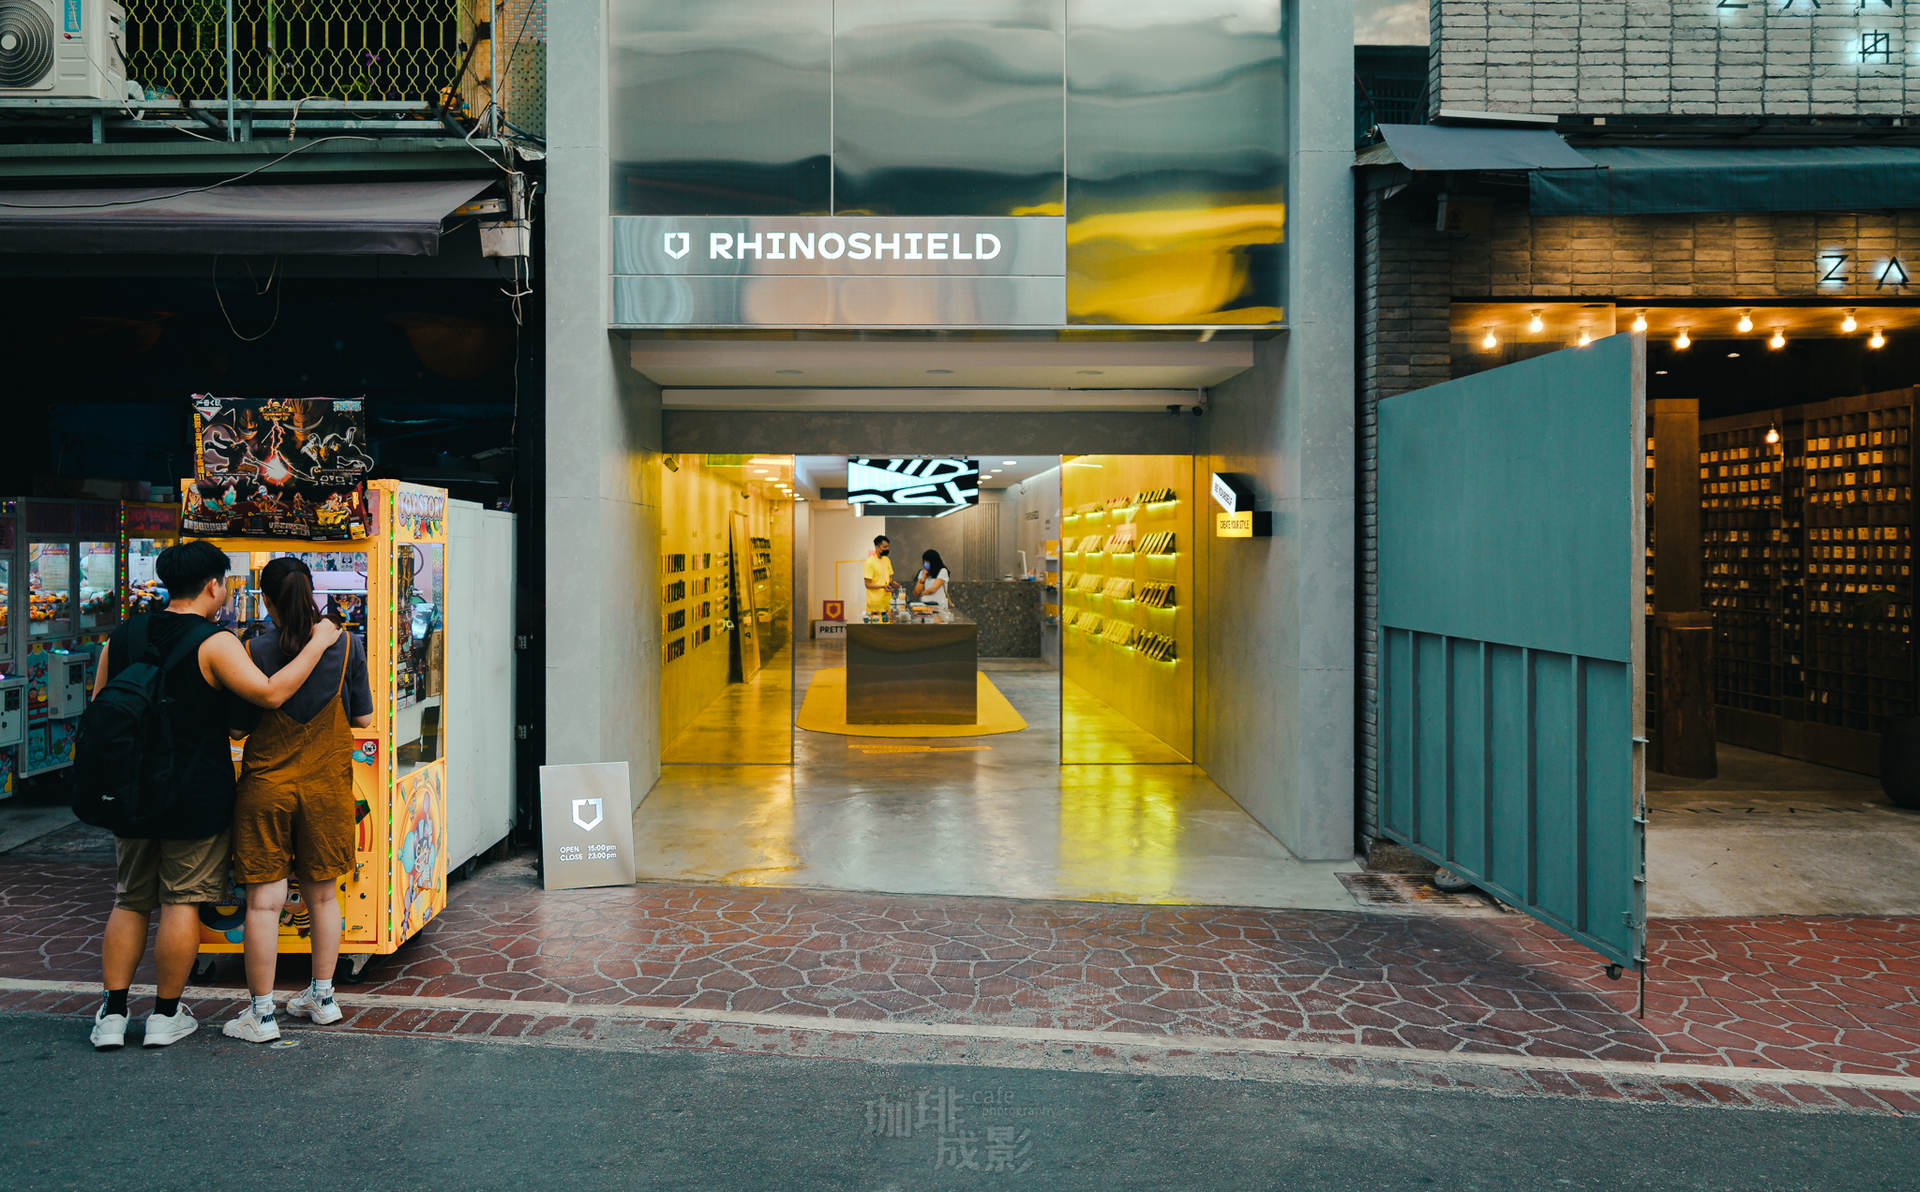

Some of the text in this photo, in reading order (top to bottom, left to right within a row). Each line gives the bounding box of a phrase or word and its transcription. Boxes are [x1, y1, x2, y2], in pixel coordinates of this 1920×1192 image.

[709, 232, 1001, 260] RHINOSHIELD
[819, 625, 847, 633] PRETT
[560, 846, 580, 854] OPEN
[560, 853, 583, 861] CLOSE
